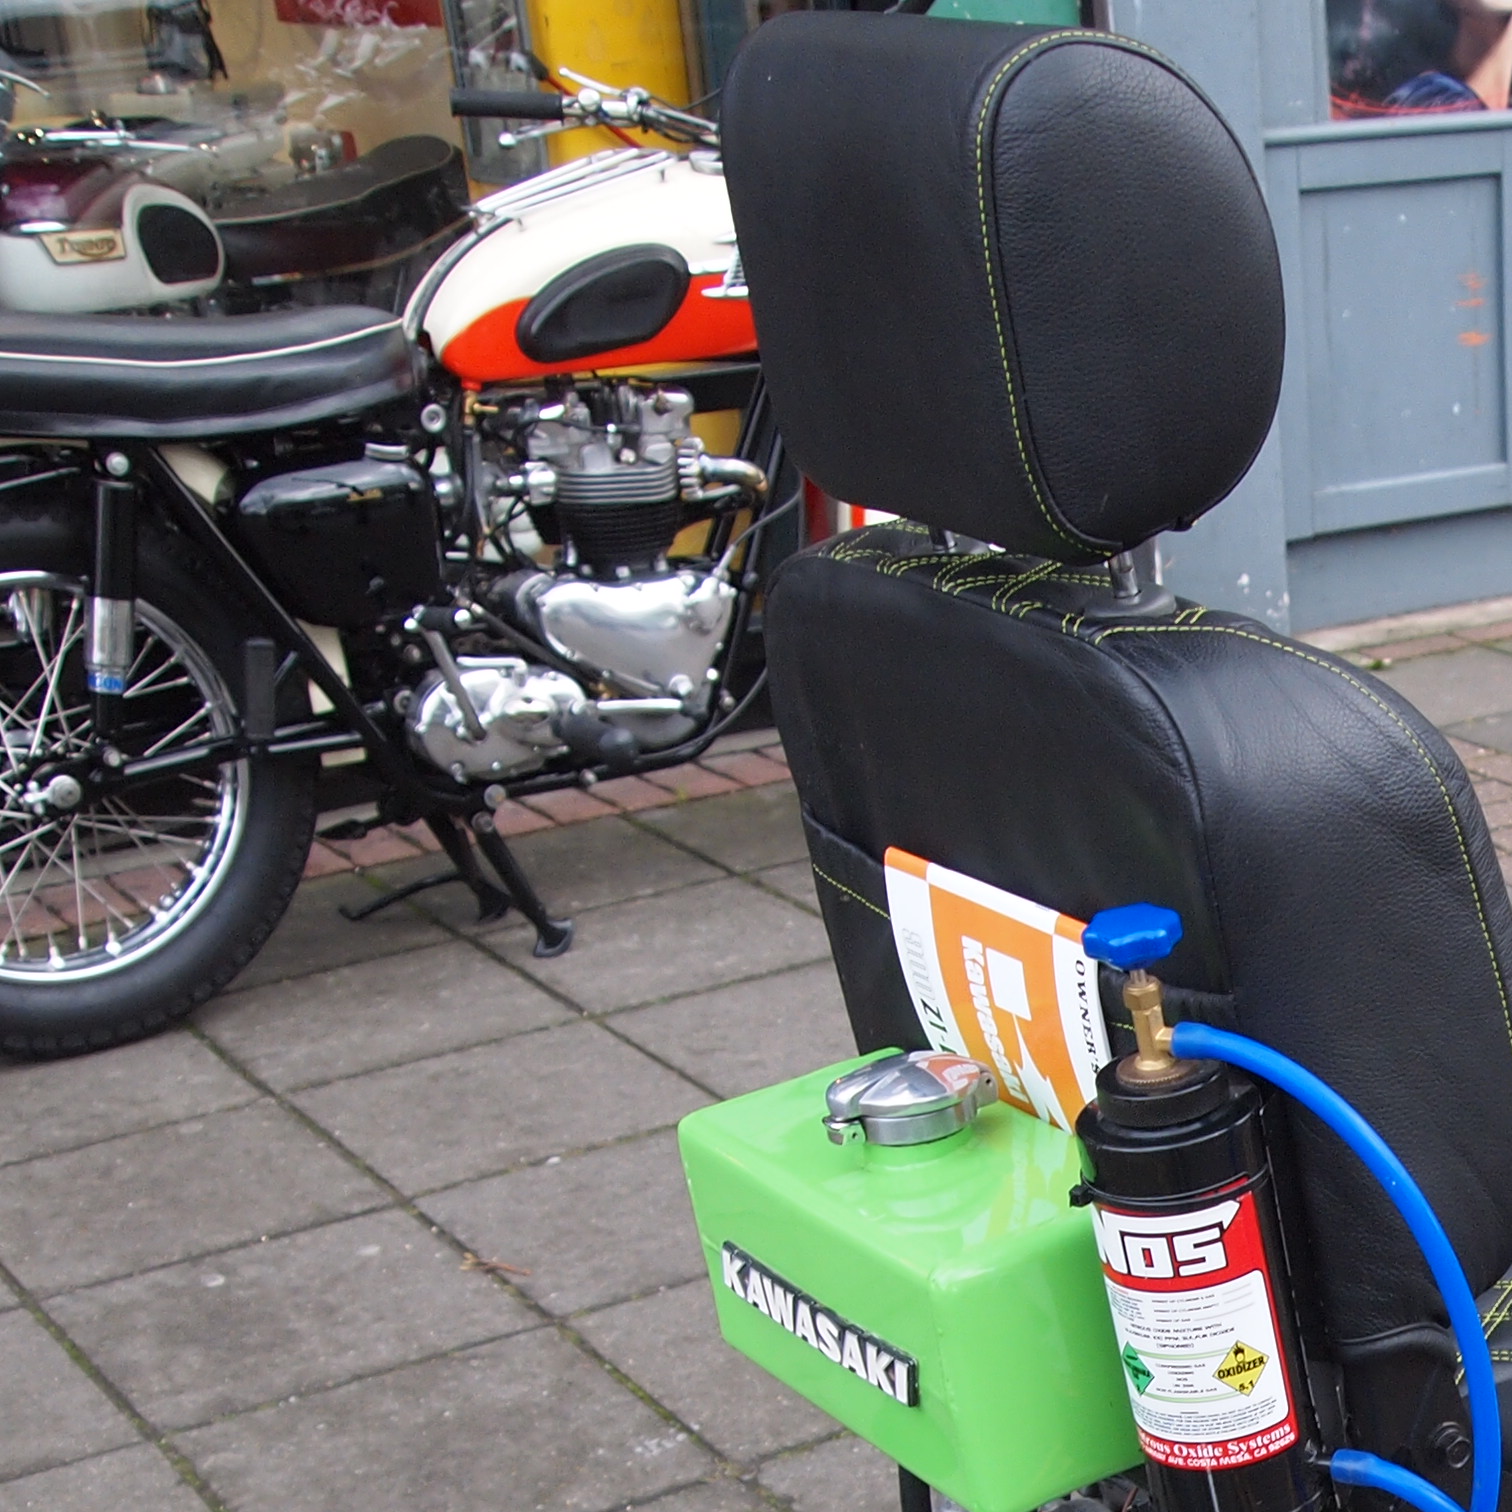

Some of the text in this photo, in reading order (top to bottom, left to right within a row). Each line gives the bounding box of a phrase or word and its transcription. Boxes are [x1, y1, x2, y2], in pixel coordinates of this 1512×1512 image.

[1093, 1199, 1241, 1279] NOS
[721, 1249, 910, 1405] KAWASAKI
[1217, 1356, 1265, 1380] OXIDIZER
[1238, 1379, 1255, 1392] 5.1
[1173, 1442, 1223, 1458] Oxide
[1226, 1423, 1292, 1454] Systems
